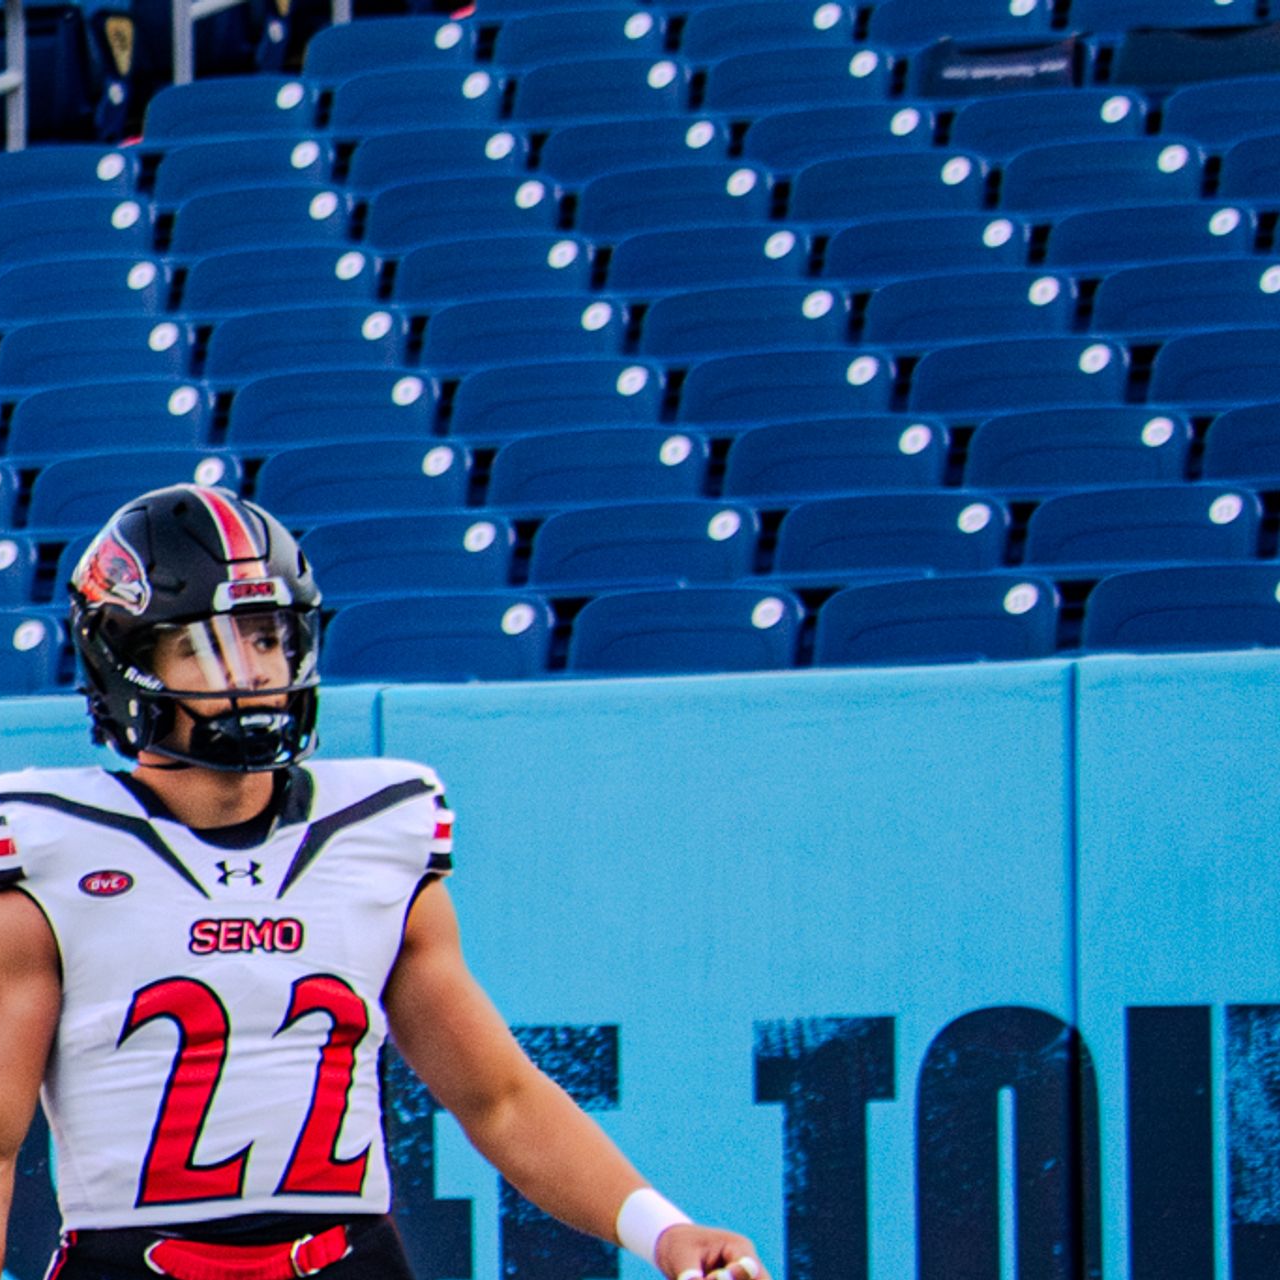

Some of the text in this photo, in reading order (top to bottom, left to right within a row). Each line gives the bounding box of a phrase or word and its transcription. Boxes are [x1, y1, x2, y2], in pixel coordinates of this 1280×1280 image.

[228, 582, 276, 599] SEMO
[188, 916, 305, 956] SEMO
[114, 972, 378, 1210] 22
